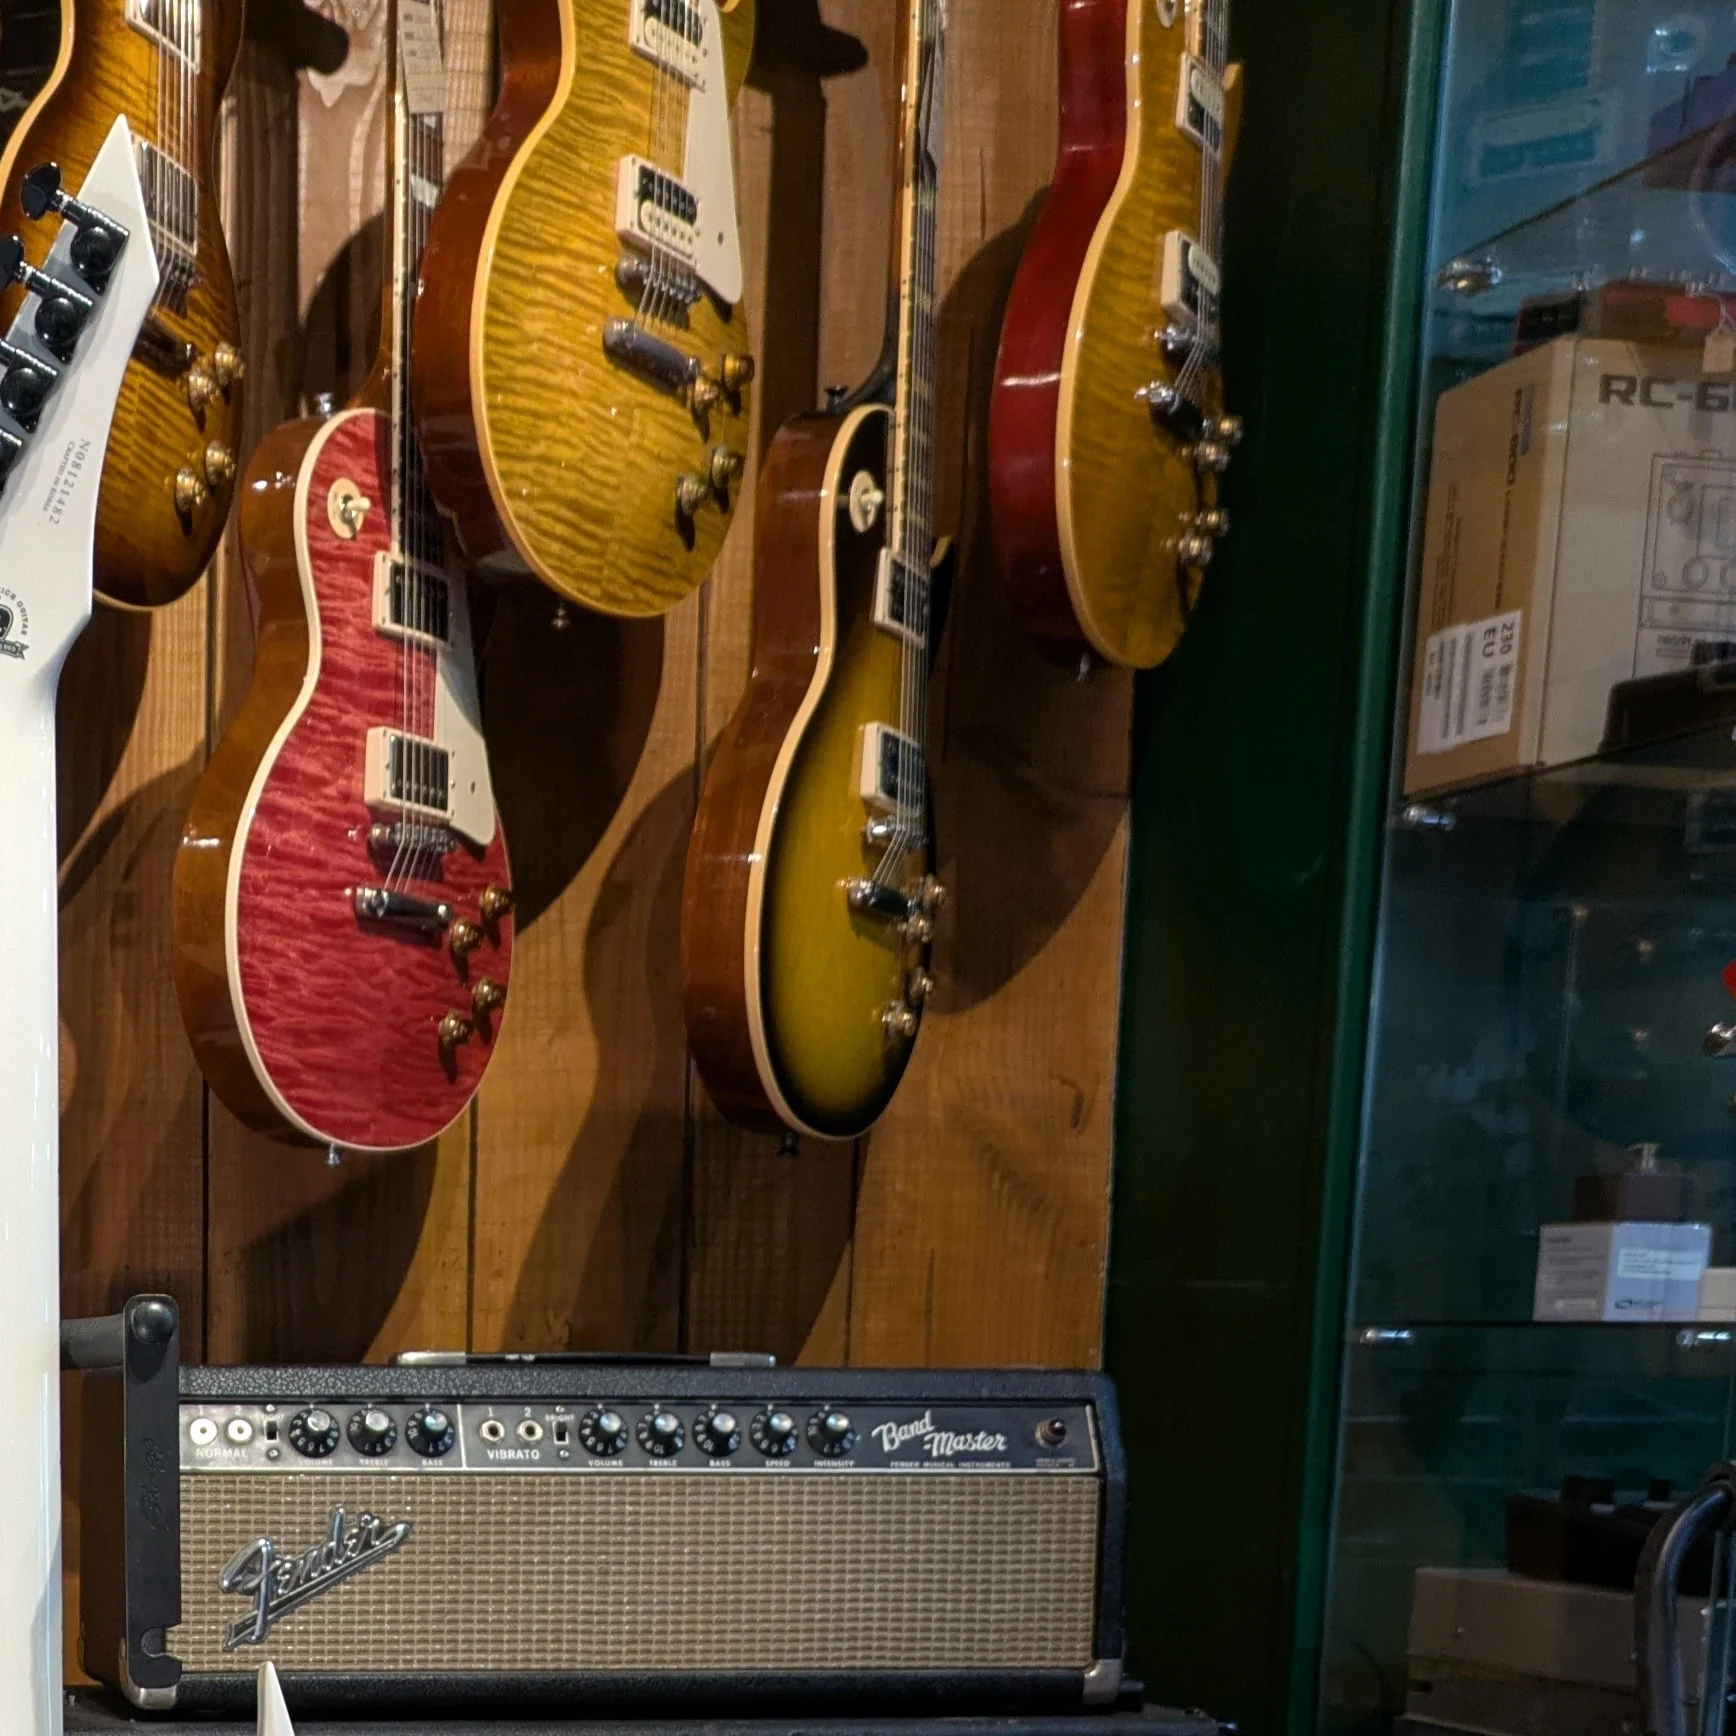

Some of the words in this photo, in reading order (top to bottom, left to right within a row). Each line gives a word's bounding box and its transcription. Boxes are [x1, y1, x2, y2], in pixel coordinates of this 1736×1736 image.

[1598, 373, 1736, 413] RC-6
[524, 1407, 532, 1417] 2
[871, 1410, 935, 1452] Band
[196, 1448, 248, 1459] NORMAL
[487, 1449, 541, 1460] VIBRATO
[422, 1458, 444, 1466] BASS
[587, 1459, 624, 1467] VOLUME
[648, 1459, 678, 1467] TREBLE
[709, 1459, 732, 1467] BASS
[765, 1459, 791, 1467] SPEED
[814, 1459, 856, 1467] INTENSITY
[219, 1504, 412, 1644] Fender
